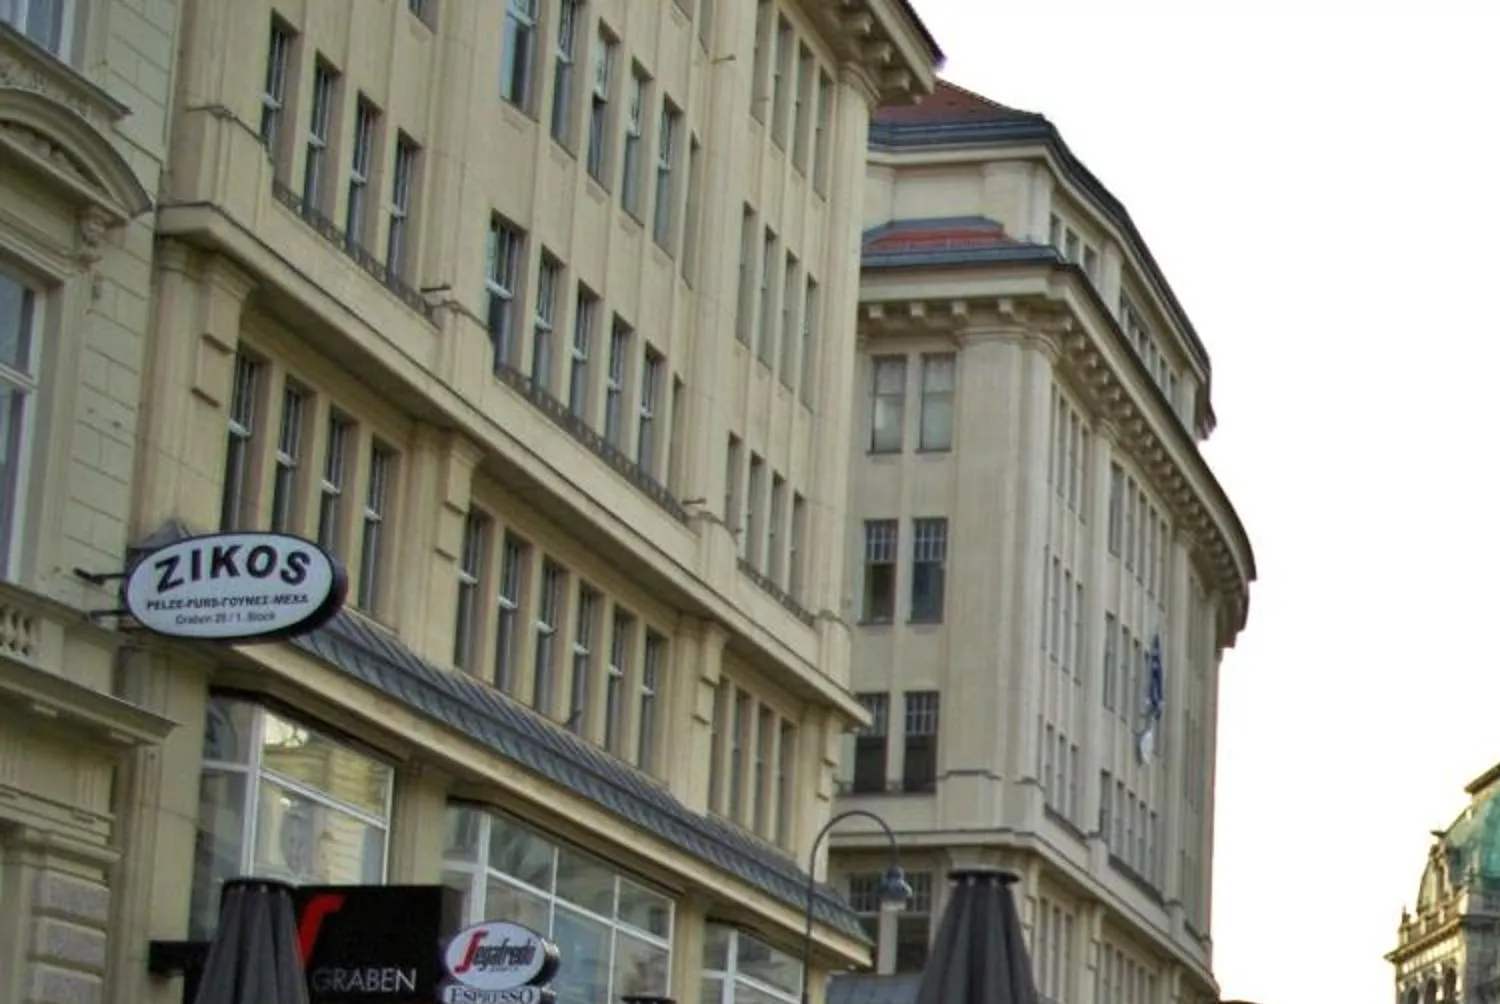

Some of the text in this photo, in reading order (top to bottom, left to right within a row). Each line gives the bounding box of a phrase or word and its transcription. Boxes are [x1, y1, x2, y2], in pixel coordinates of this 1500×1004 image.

[154, 544, 311, 594] ZIKOS
[312, 967, 417, 992] GRABEN
[451, 987, 534, 1004] ESPRESSO
